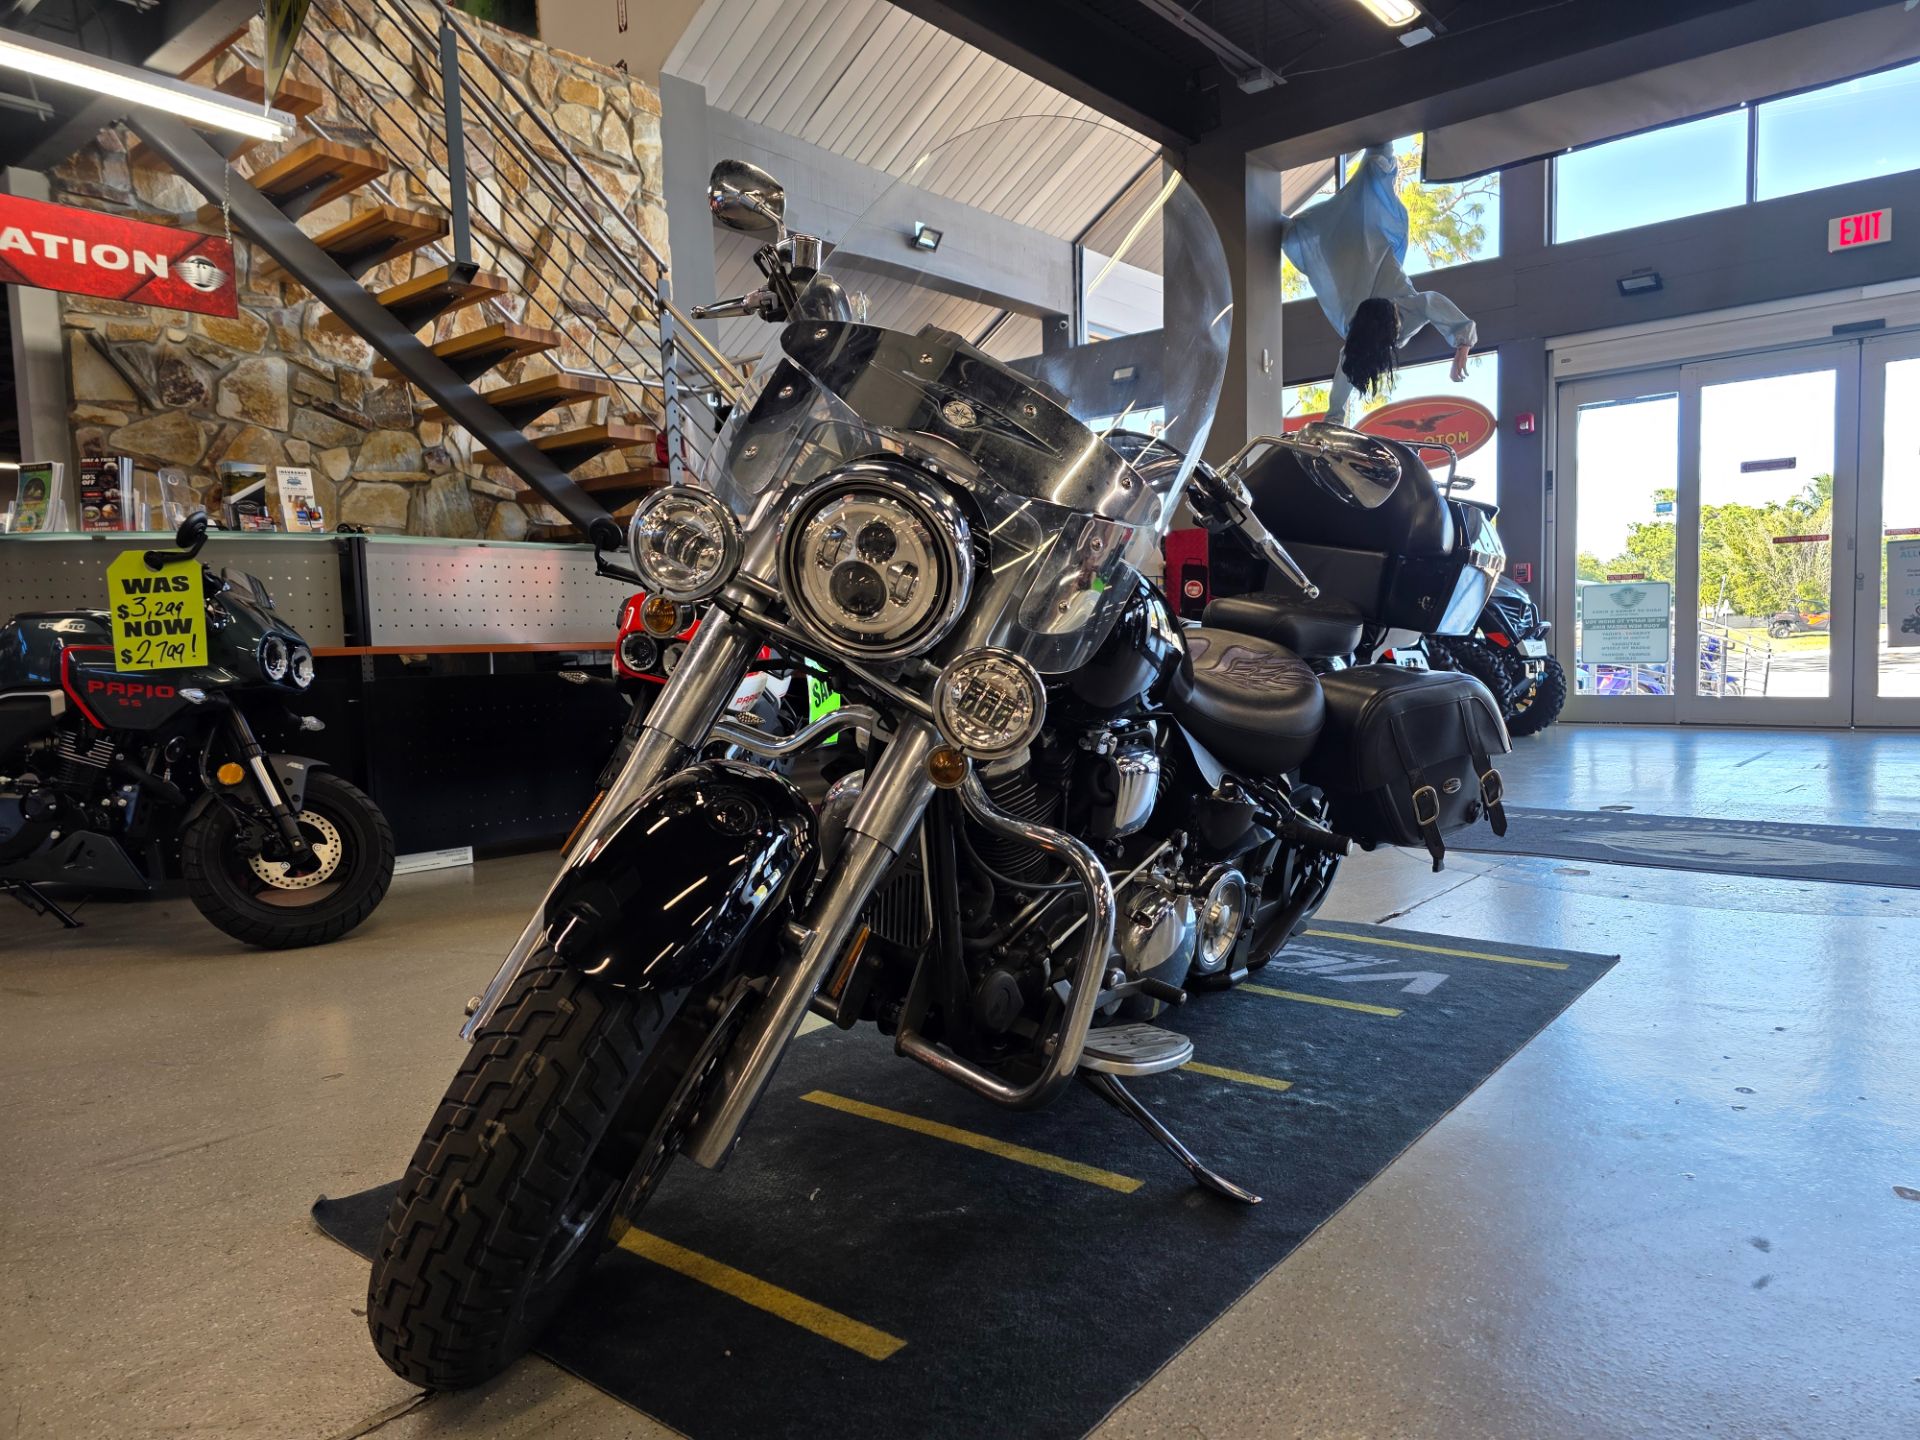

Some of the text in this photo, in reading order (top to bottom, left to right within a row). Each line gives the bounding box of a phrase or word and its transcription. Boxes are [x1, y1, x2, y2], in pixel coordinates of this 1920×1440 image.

[1839, 211, 1882, 246] EXIT
[0, 226, 170, 280] ATION
[121, 575, 190, 595] WAS
[117, 596, 185, 620] $3,299
[124, 618, 193, 638] NOW
[87, 680, 175, 699] PAPIO
[736, 693, 759, 704] PAP
